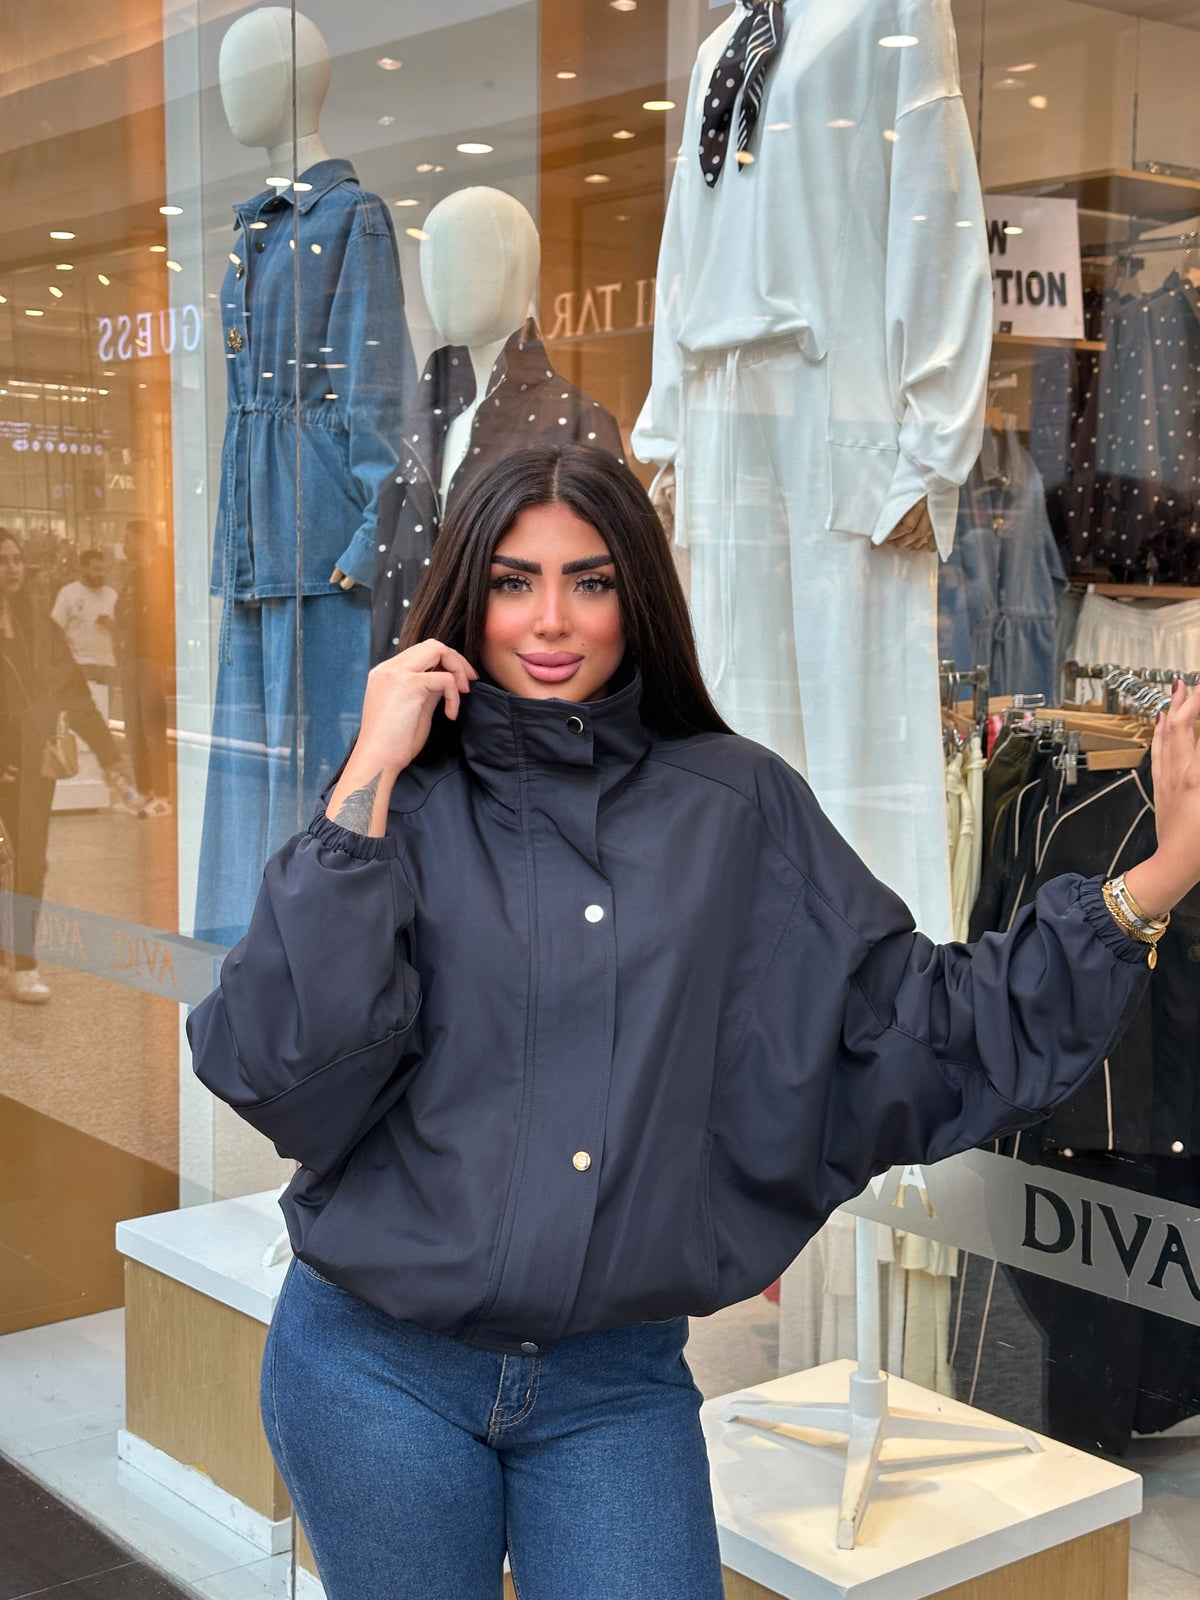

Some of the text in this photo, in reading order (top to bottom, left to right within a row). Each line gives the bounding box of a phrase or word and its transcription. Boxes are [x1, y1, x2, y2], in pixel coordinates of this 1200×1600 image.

[993, 269, 1067, 307] TION
[115, 931, 178, 988] DIVA
[1022, 1183, 1200, 1301] DIVA
